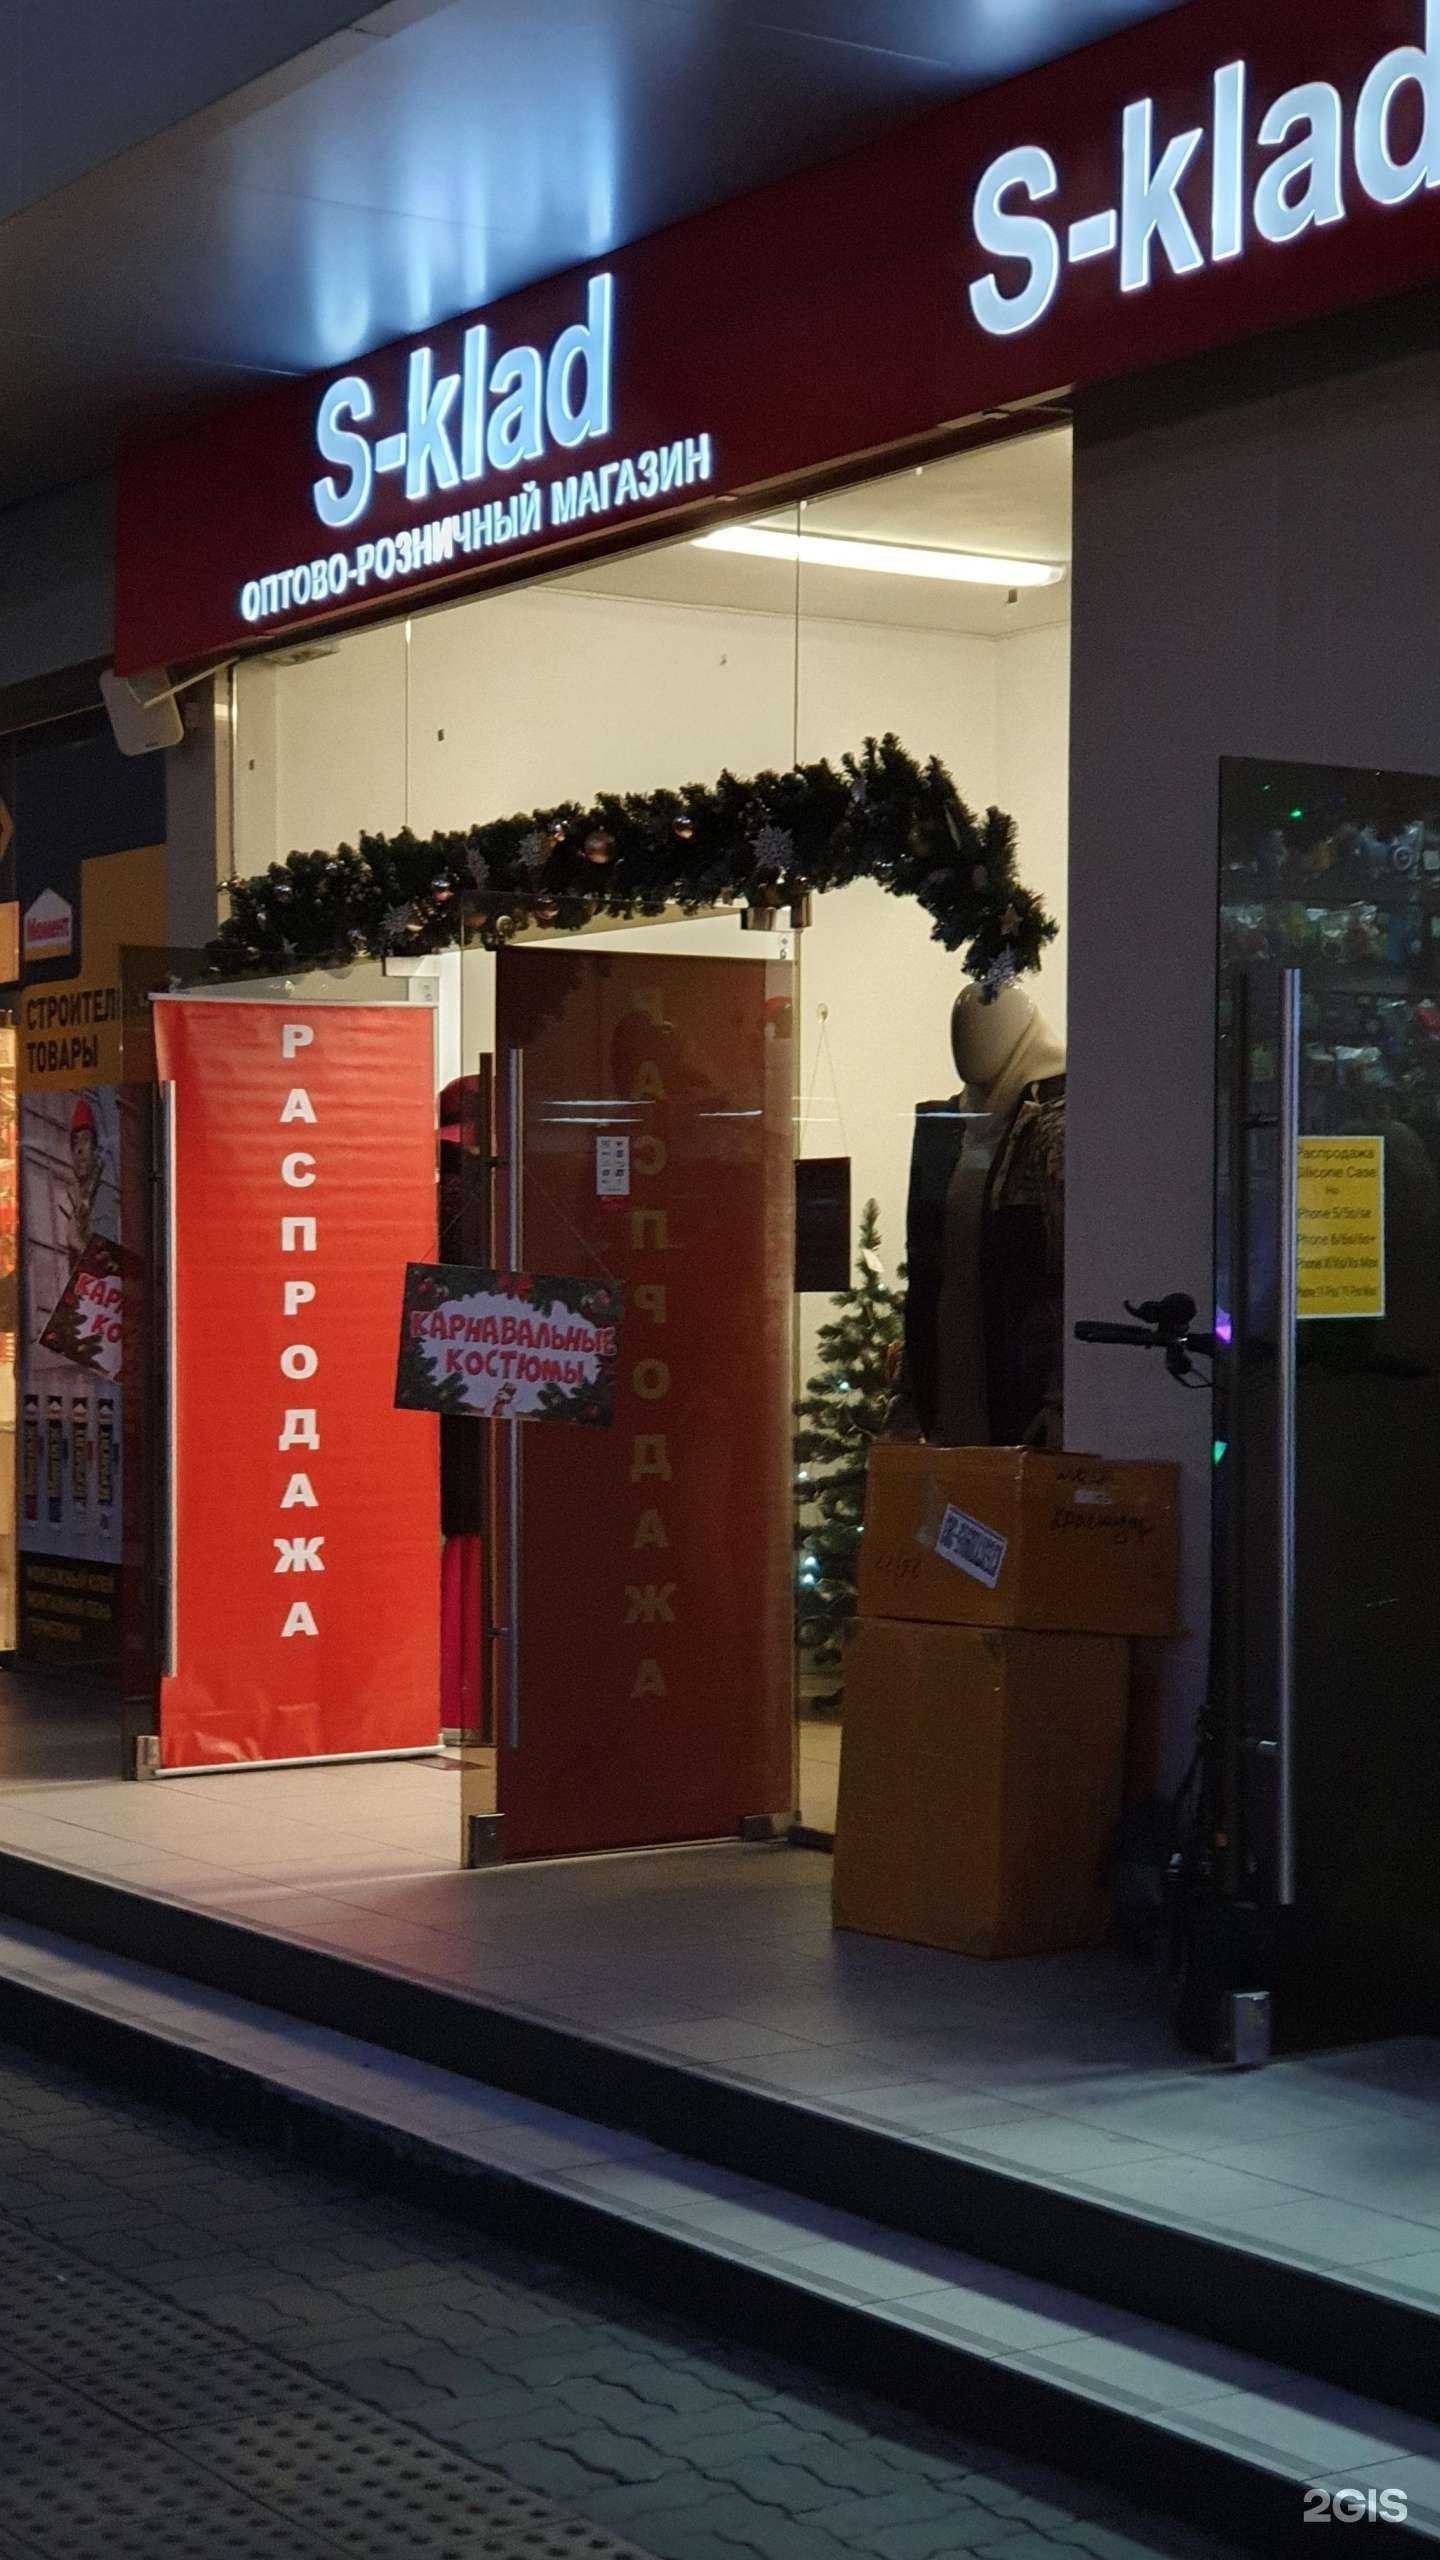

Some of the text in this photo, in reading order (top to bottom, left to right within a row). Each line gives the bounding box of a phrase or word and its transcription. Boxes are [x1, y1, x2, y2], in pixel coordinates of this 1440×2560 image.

[970, 0, 1440, 335] S-klad
[313, 272, 613, 527] S-klad
[241, 433, 711, 623] ОПТОВО-РОЗНИЧНЫЙ МАГАЗИН
[26, 987, 117, 1032] СТРОИТЕЛ
[26, 1034, 98, 1074] ТОВАРЫ
[1346, 1165, 1376, 1179] Case
[273, 1023, 325, 1637] РАСПРОДАЖА
[410, 1311, 615, 1354] КАРНАВАЛЬНЫЕ
[446, 1348, 584, 1385] КОСТЮМЫ
